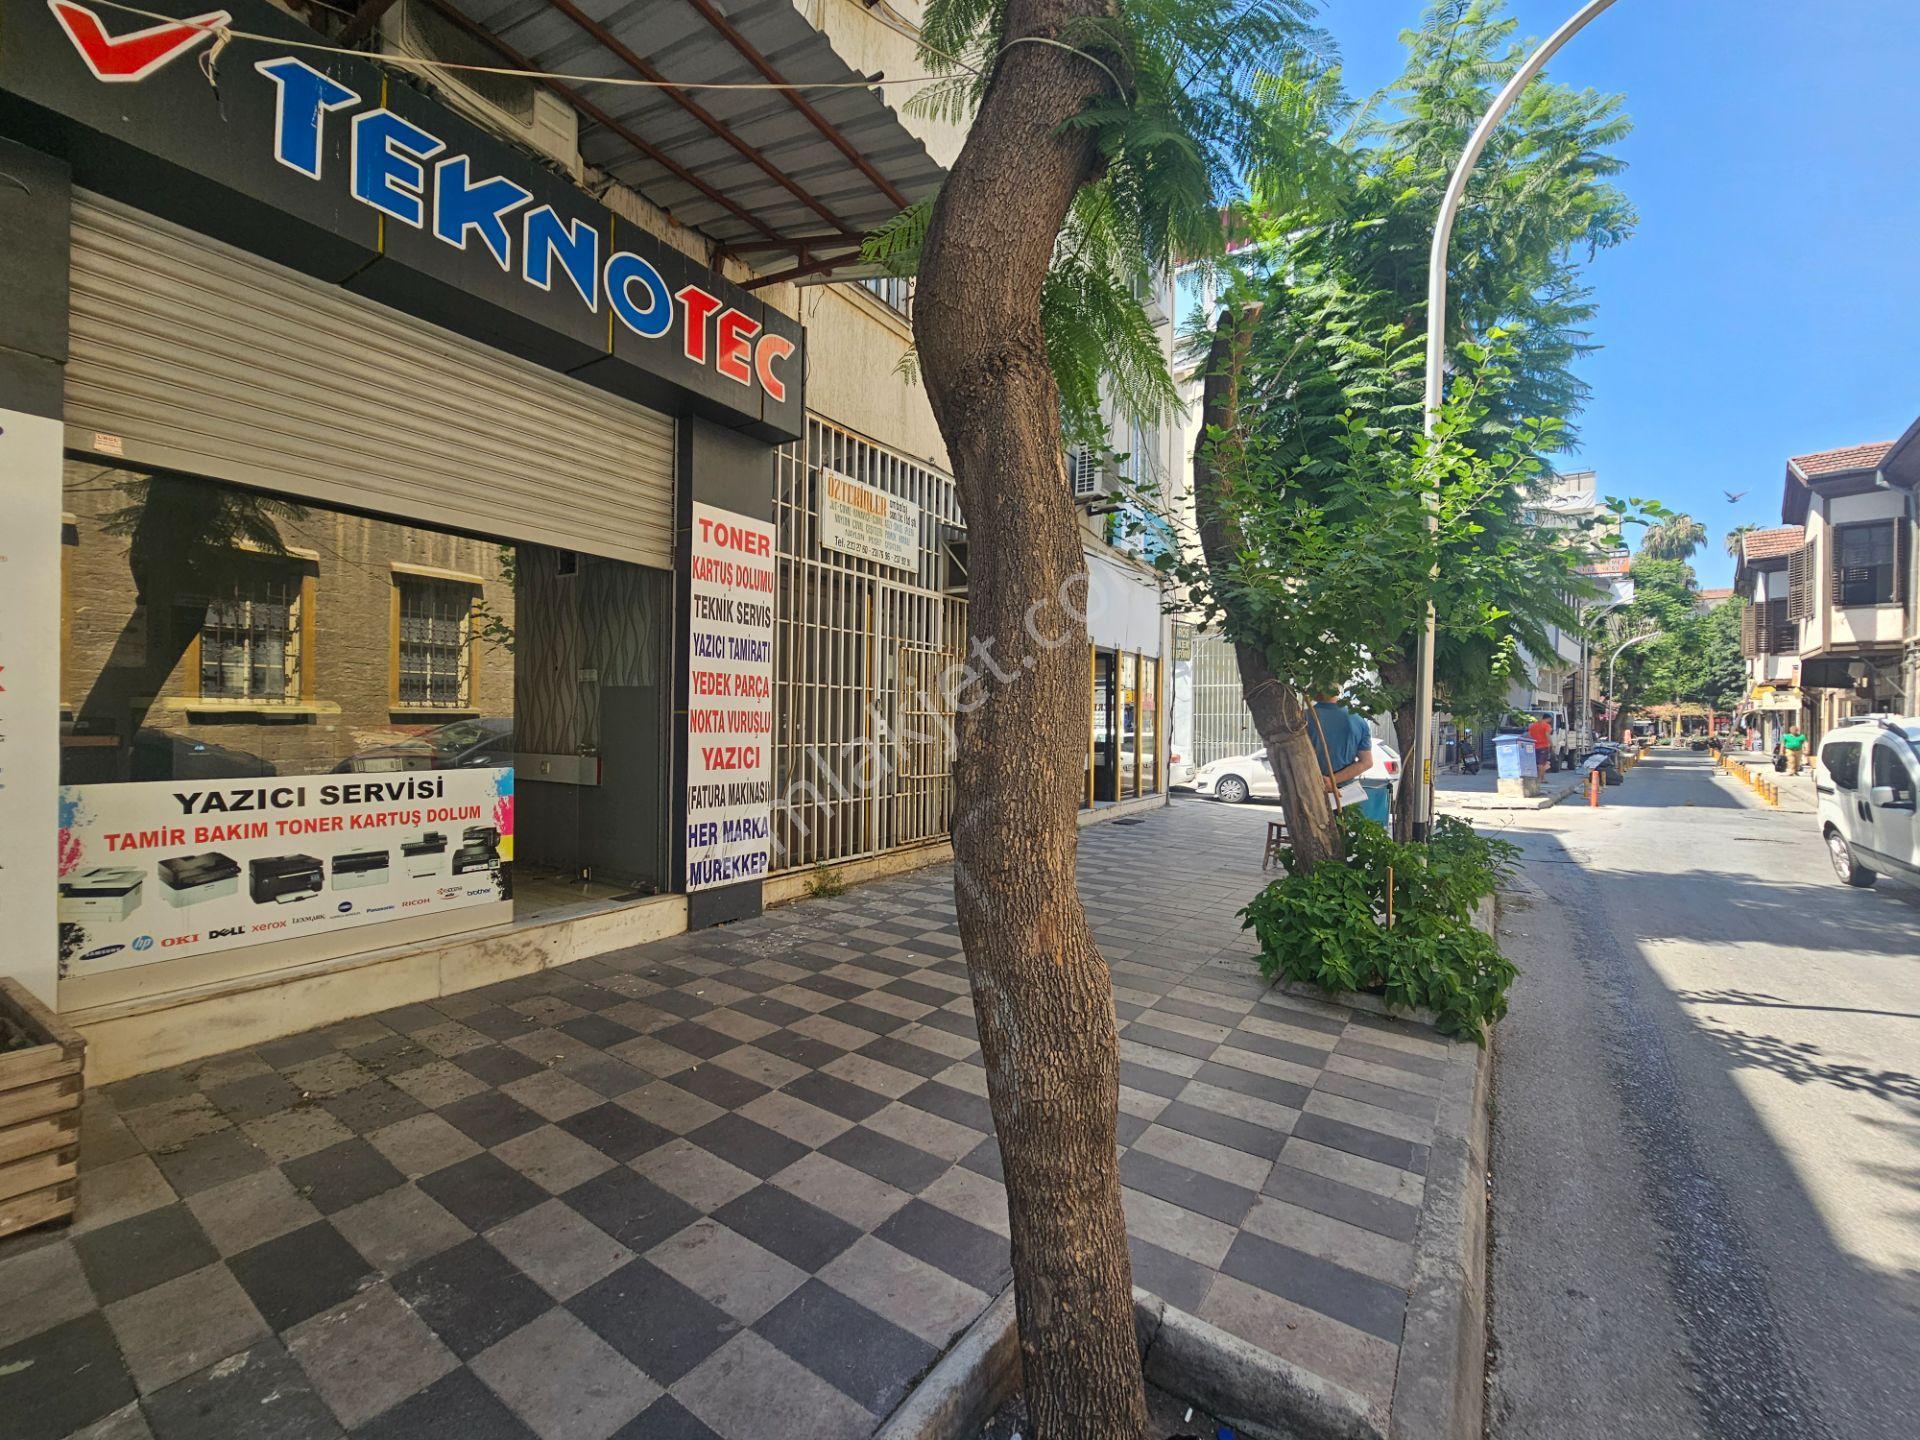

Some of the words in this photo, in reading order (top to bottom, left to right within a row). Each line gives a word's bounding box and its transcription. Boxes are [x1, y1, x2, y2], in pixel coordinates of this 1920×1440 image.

[255, 56, 796, 404] TEKNOTEC
[698, 517, 770, 558] TONER
[835, 535, 846, 548] Tel.
[692, 555, 733, 591] KARTUŞ
[735, 564, 774, 594] DOLUMU
[694, 593, 734, 623] TEKNİK
[736, 600, 771, 629] SERVİS
[693, 632, 725, 659] YAZICI
[728, 634, 770, 663] TAMİRATI
[692, 671, 732, 696] YEDEK
[734, 673, 770, 703] PARÇA
[690, 709, 725, 734] NOKTA
[727, 711, 771, 739] VURUŞLU
[701, 746, 760, 771] YAZICI
[173, 786, 305, 815] YAZICI
[319, 775, 444, 806] SERVİSİ
[688, 783, 726, 816] (FATURA
[728, 777, 770, 809] MAKİNASI)
[104, 825, 185, 852] TAMİR
[194, 822, 268, 844] BAKIM
[275, 816, 343, 836] TONER
[350, 810, 421, 829] KARTUŞ
[427, 805, 481, 823] DOLUM
[688, 822, 718, 849] HER
[722, 816, 769, 844] MARKA
[690, 851, 768, 886] MÜREKKEP
[133, 936, 153, 951] hp
[161, 933, 200, 948] OKI
[208, 925, 246, 940] DELL
[251, 920, 287, 933] xerox
[401, 898, 430, 908] RICOH
[467, 887, 491, 897] brother
